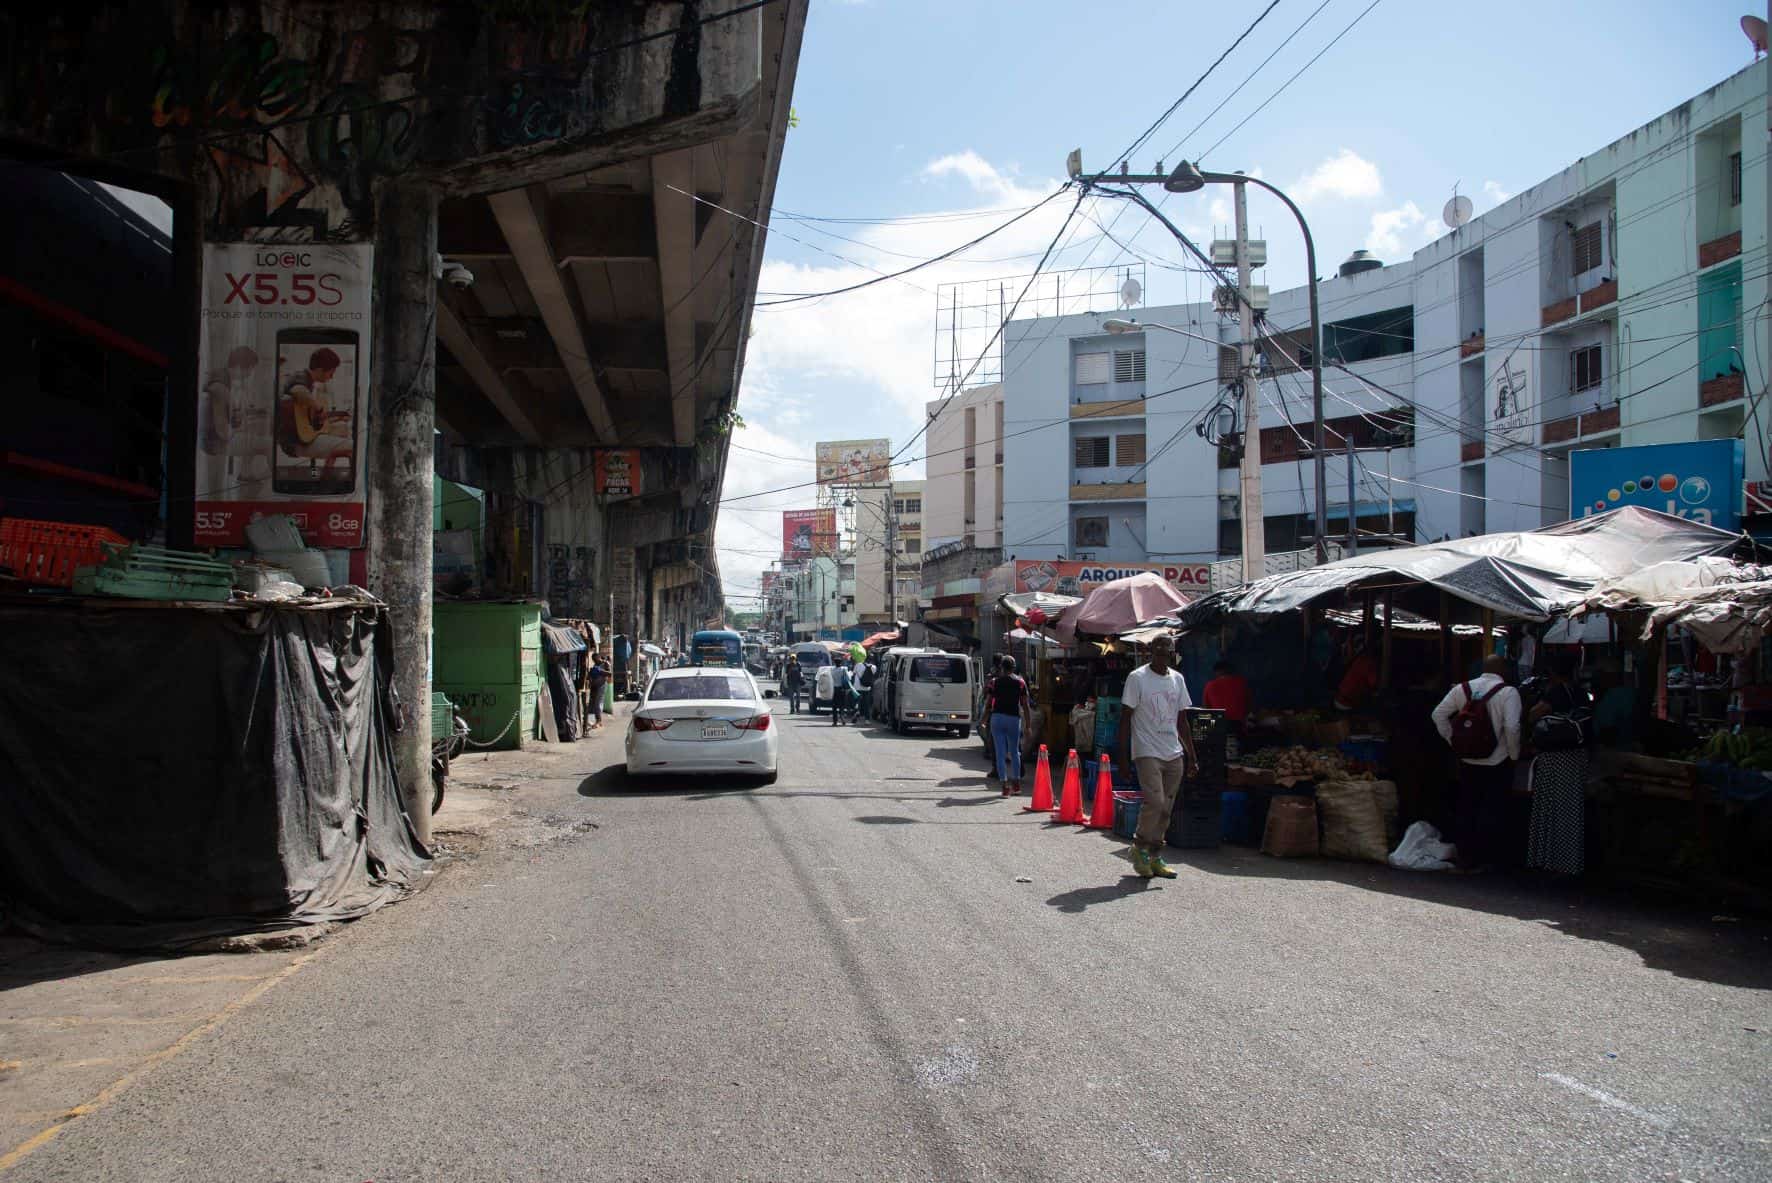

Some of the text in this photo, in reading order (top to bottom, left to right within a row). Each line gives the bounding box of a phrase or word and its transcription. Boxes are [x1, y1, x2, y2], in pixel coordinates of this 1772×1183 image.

[256, 252, 312, 268] LOGIC
[223, 272, 343, 306] X5.5S
[1164, 567, 1209, 585] PAC
